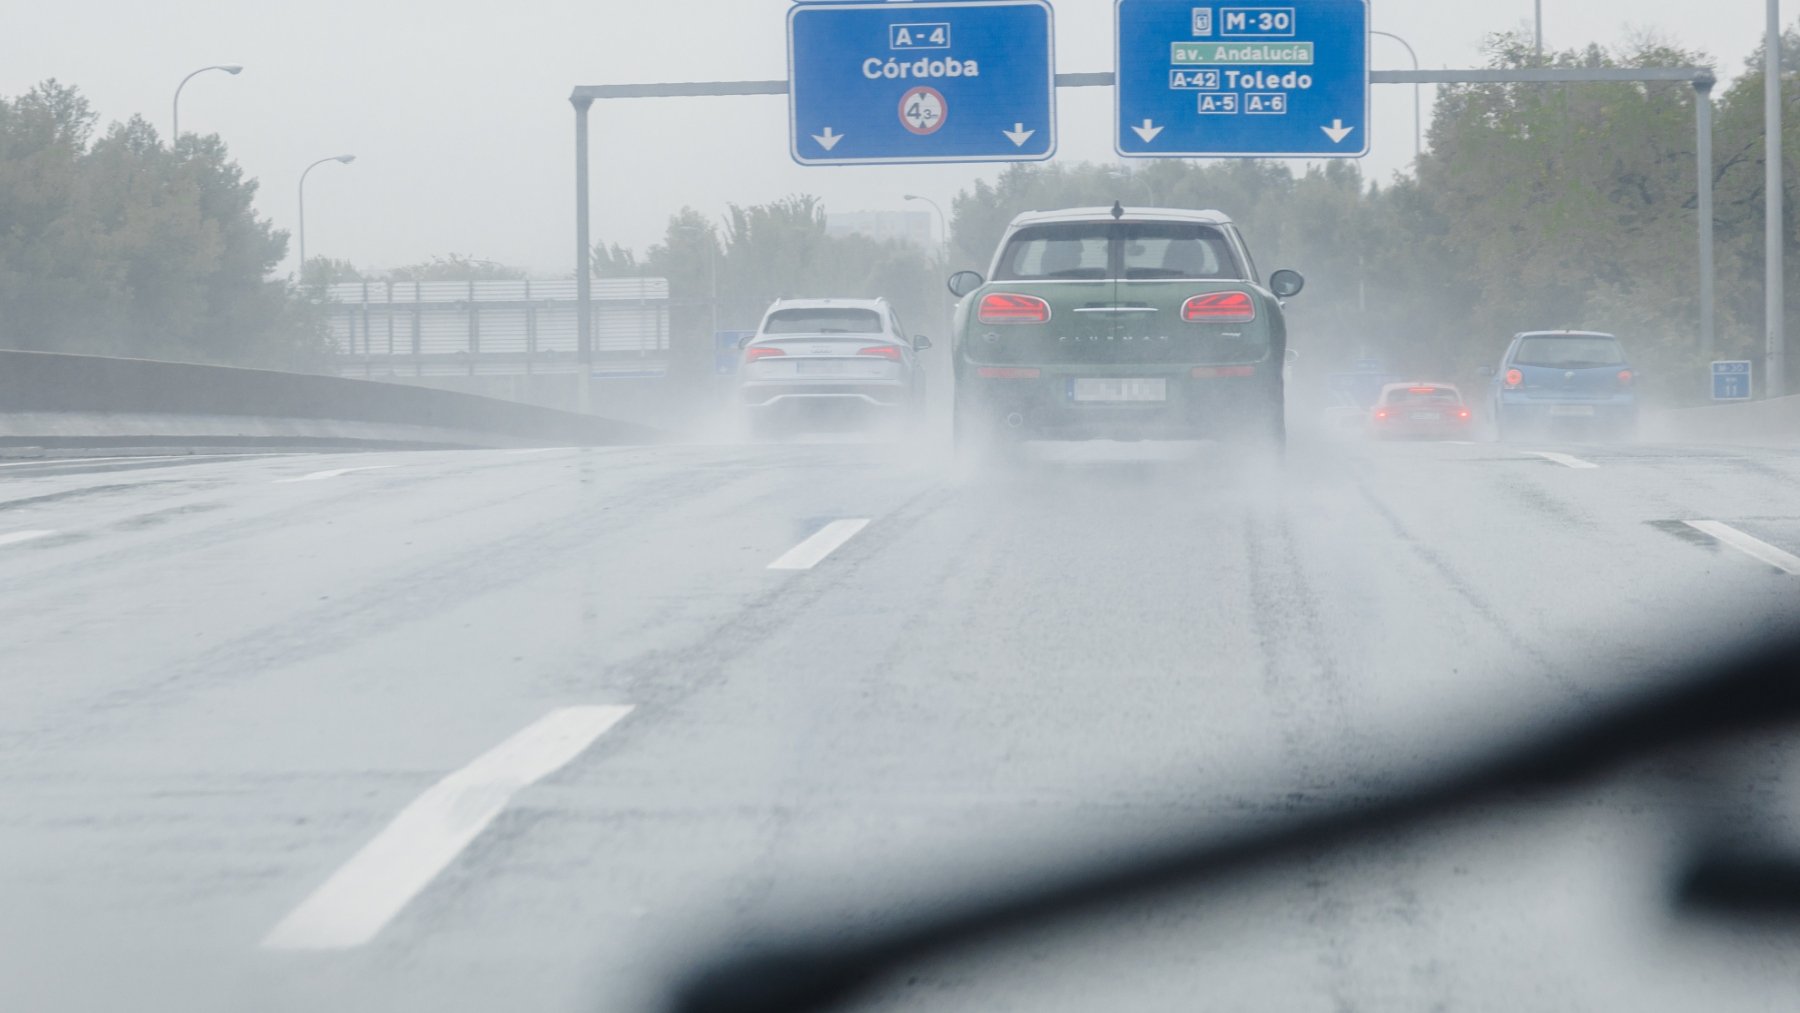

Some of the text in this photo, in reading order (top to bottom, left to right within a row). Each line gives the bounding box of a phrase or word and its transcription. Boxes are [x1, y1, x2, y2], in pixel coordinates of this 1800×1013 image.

[1226, 12, 1290, 31] M-30
[895, 27, 946, 46] A-4
[1175, 45, 1309, 61] av. Andalucía
[862, 56, 980, 79] Córdoba
[1173, 71, 1313, 89] A-42 Toledo
[1201, 97, 1284, 110] A-5 A-6
